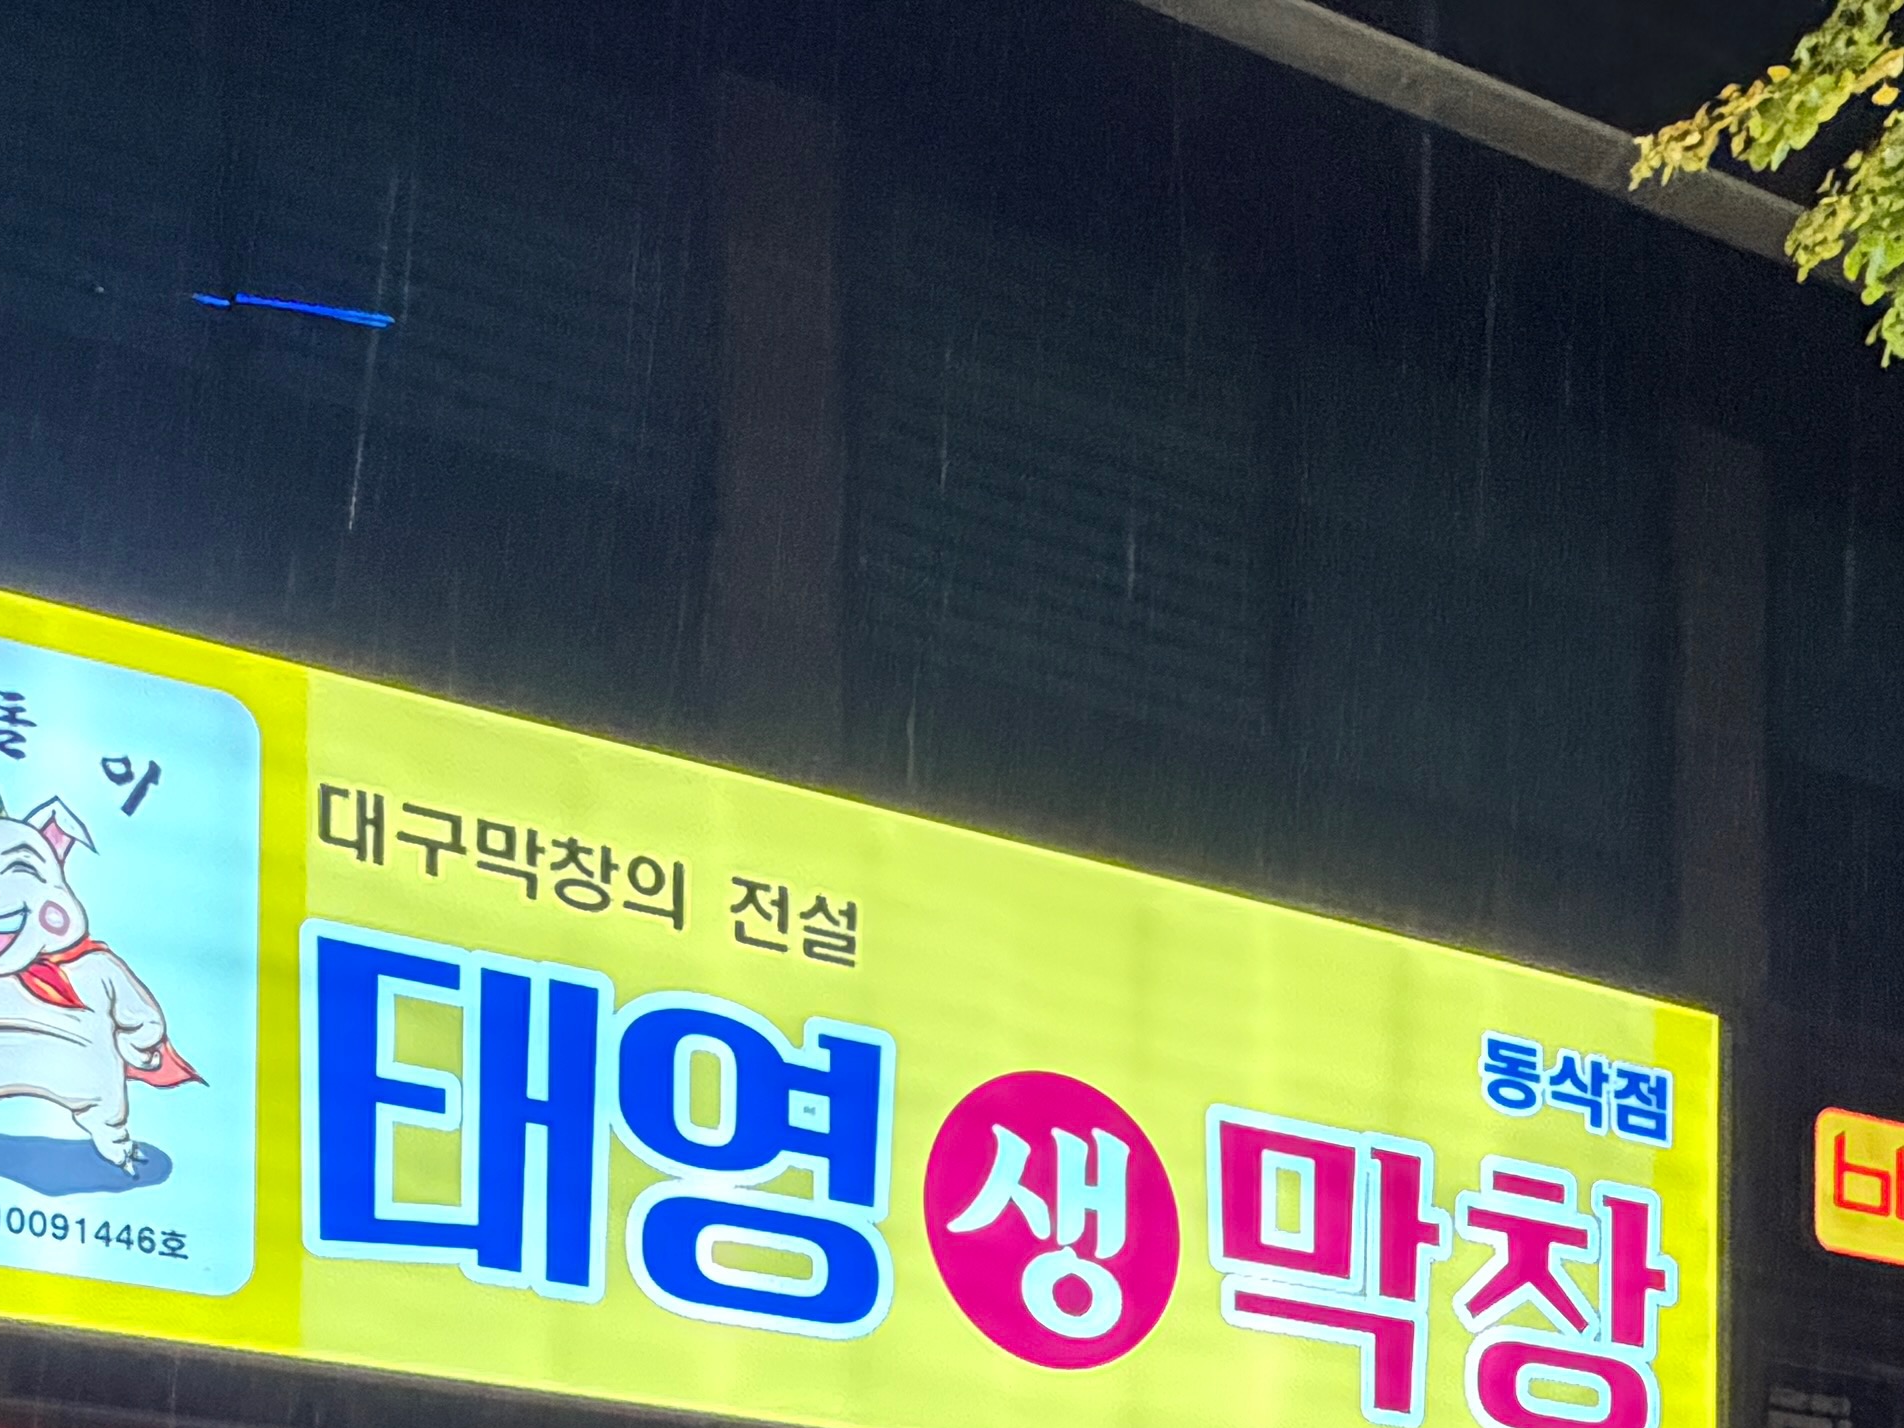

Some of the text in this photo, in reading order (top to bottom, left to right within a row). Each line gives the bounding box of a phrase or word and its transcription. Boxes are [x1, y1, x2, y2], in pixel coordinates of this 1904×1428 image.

[317, 781, 859, 968] 대구막창의 전설
[1482, 1034, 1672, 1146] 동삭점
